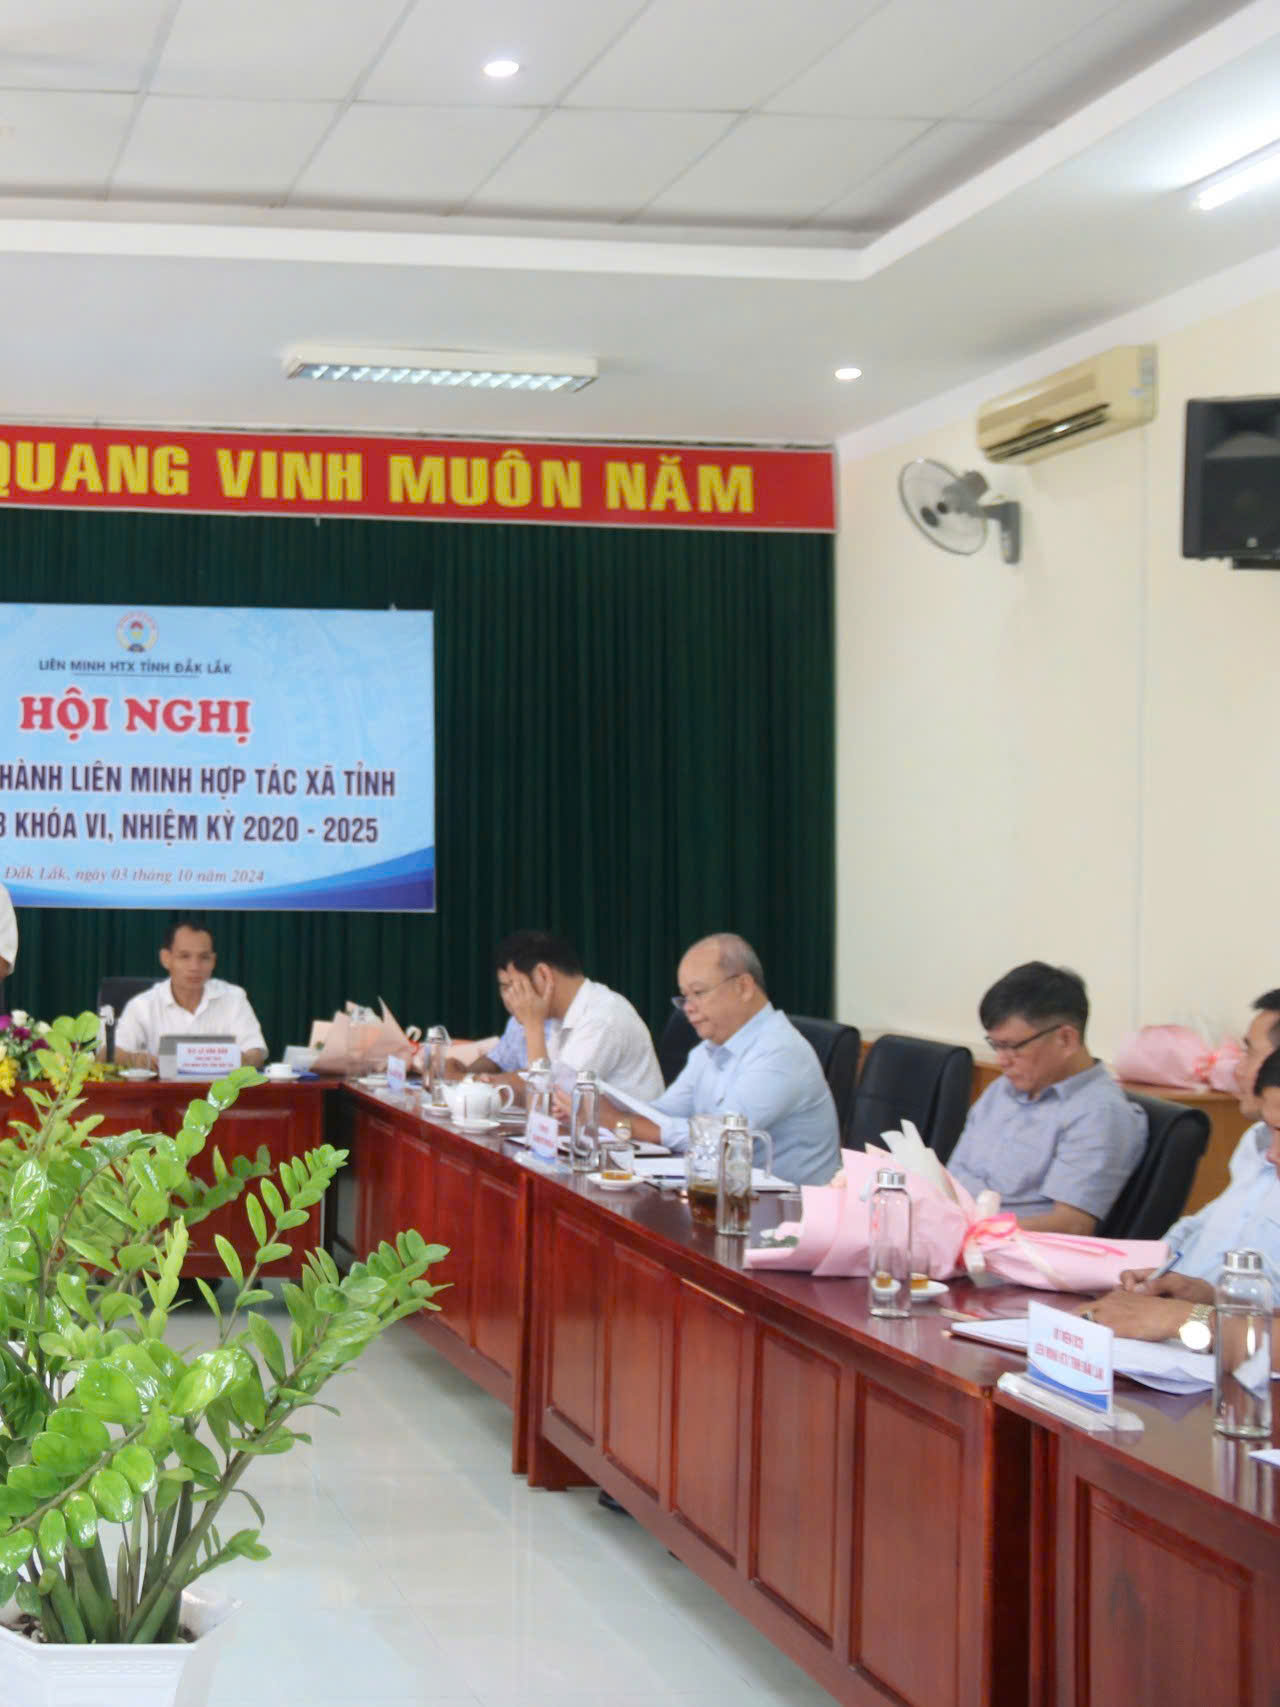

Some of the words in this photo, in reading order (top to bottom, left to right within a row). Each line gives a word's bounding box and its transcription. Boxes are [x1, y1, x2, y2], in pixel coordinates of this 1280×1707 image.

[217, 449, 363, 501] VINH
[389, 450, 582, 509] MUÔN
[606, 454, 754, 513] NĂM
[39, 658, 66, 671] LIÊN
[71, 660, 105, 672] MINH
[110, 661, 135, 672] HTX
[21, 687, 108, 741] HỘI
[125, 698, 250, 743] NGHỊ
[0, 759, 62, 791] HÀNH
[71, 761, 122, 792] LIÊN
[131, 767, 192, 793] MINH
[201, 766, 246, 799] HỢP
[255, 764, 297, 795] TÁC
[306, 766, 335, 796] XÃ
[344, 762, 395, 796] TỈNH
[15, 807, 77, 839] KHÓA
[86, 813, 114, 843] VI,
[122, 809, 197, 847] NHIỆM
[207, 809, 235, 841] KỲ
[243, 816, 299, 842] 2020
[323, 817, 378, 843] 2025
[178, 869, 193, 882] 10
[231, 869, 264, 883] 2024
